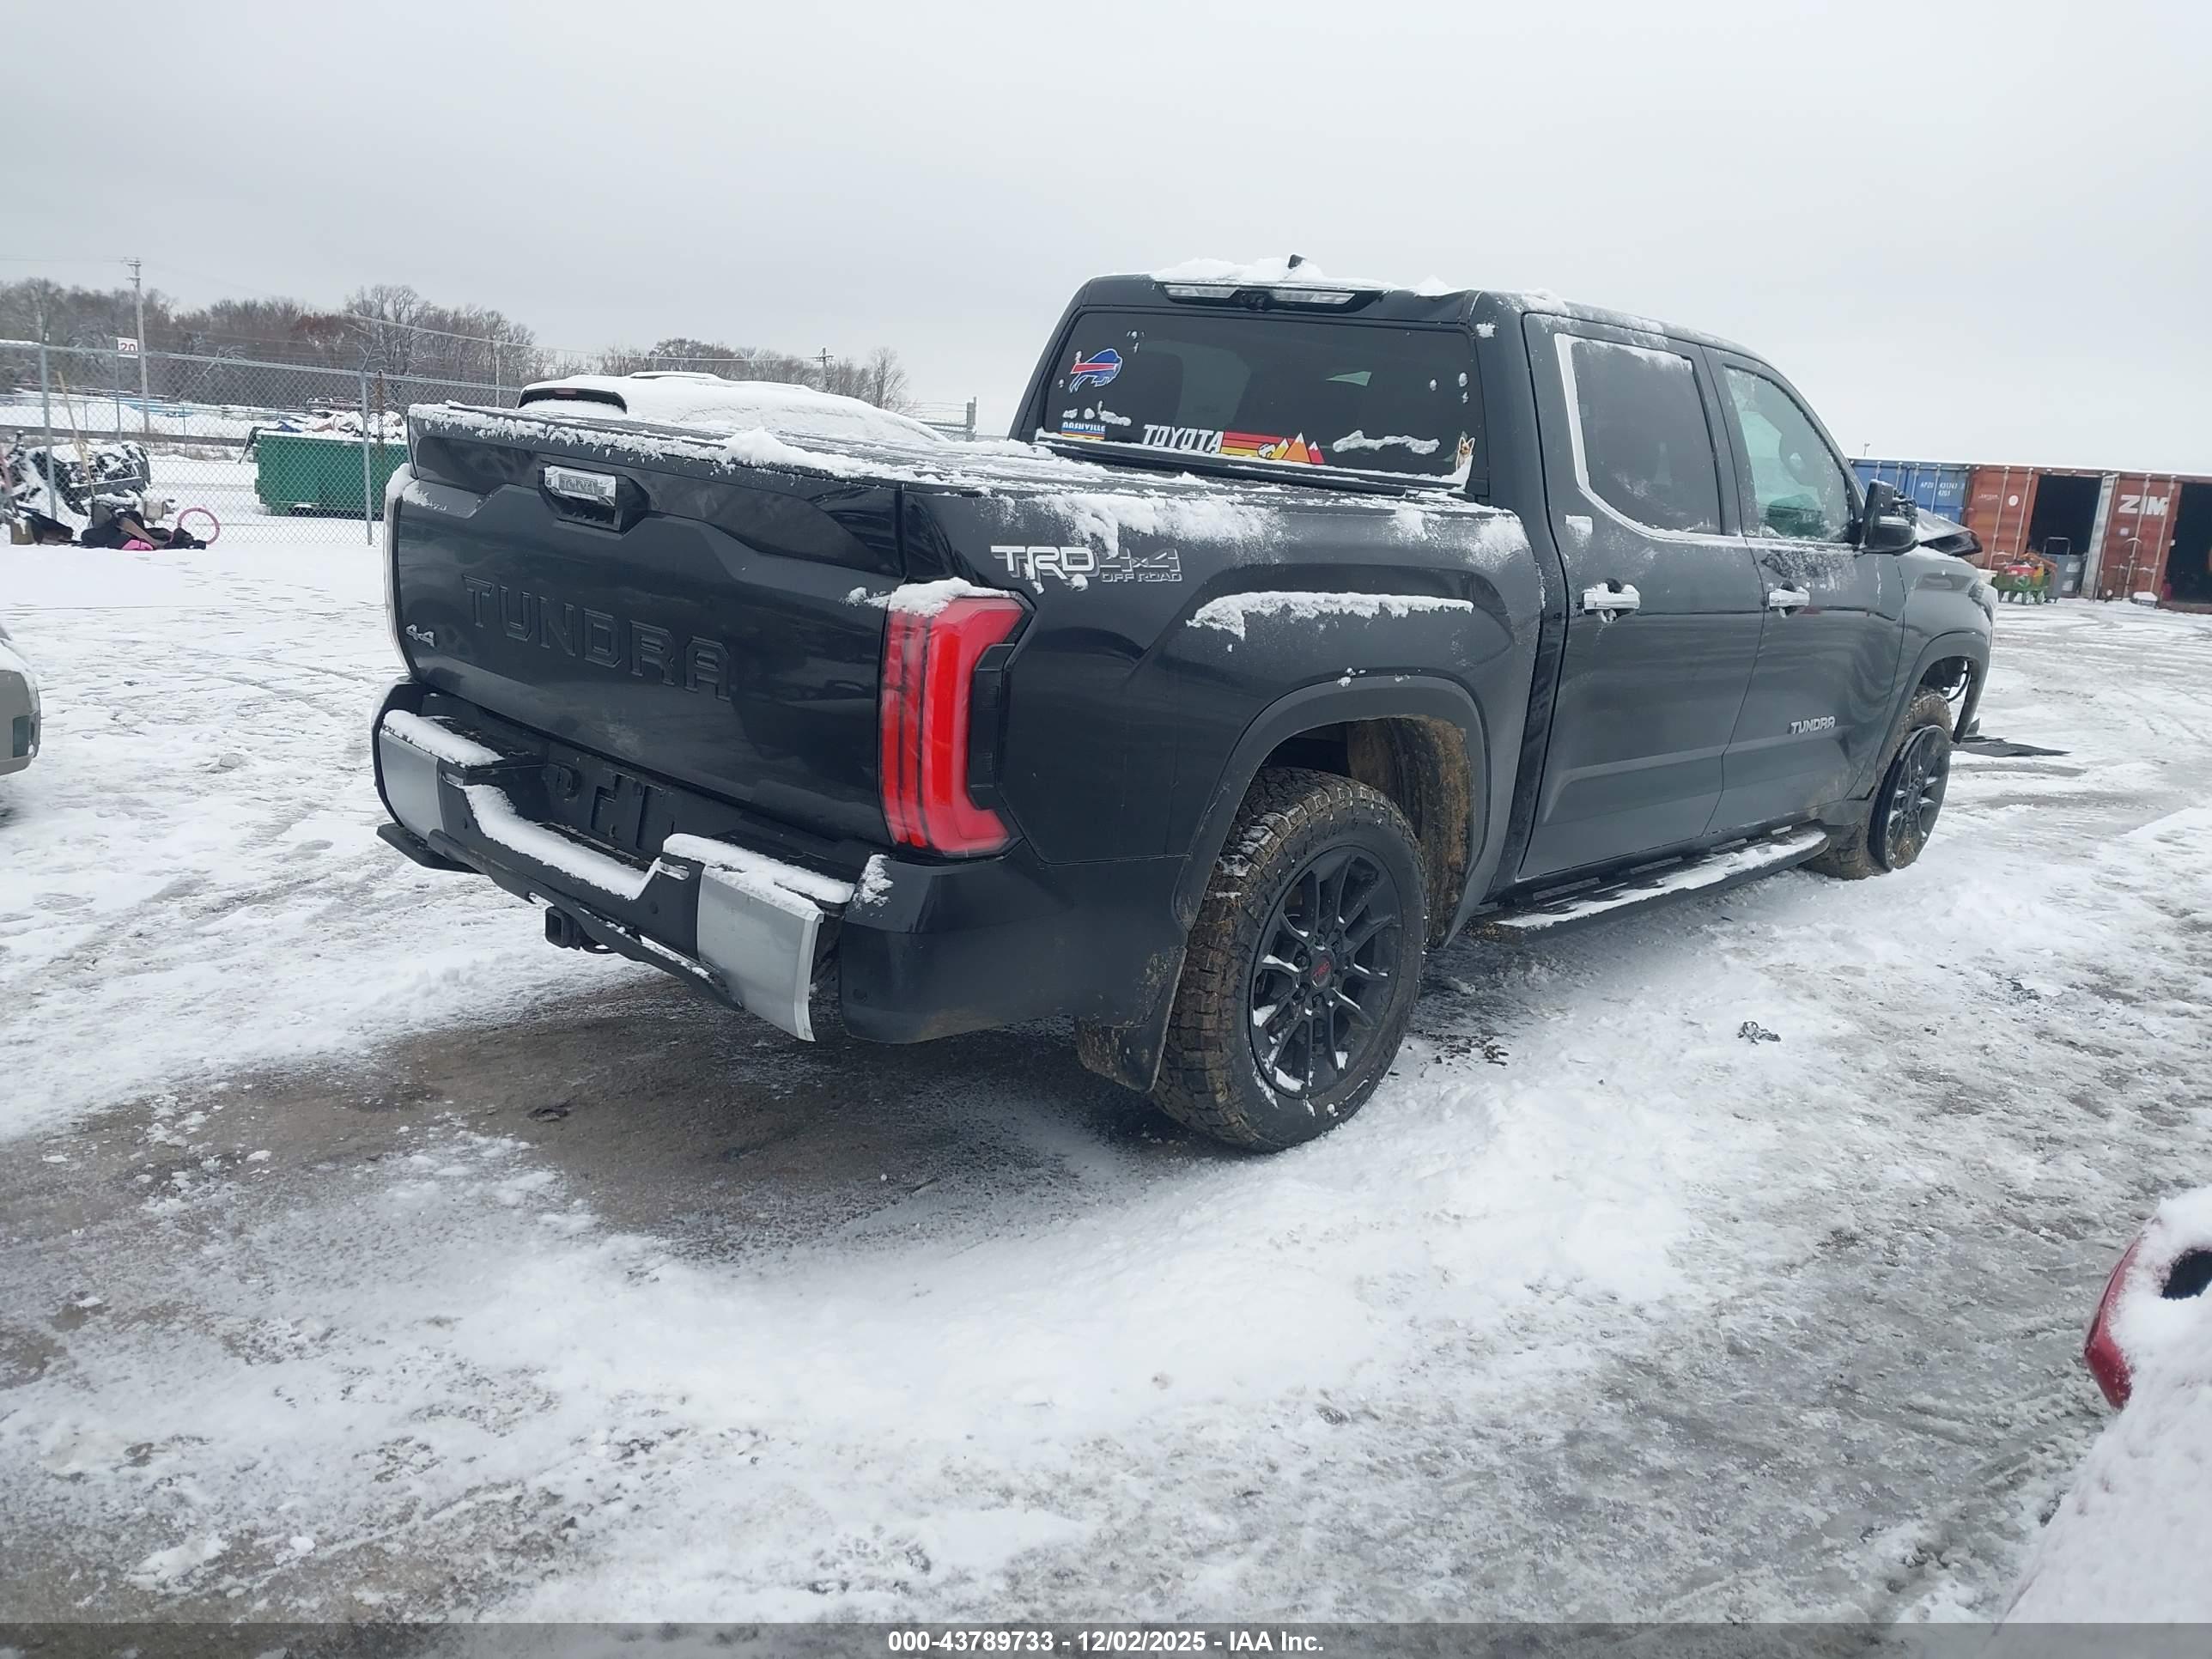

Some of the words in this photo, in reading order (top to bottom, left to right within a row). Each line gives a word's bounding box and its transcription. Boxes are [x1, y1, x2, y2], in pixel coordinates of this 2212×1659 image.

[1143, 424, 1224, 453] TOYOTA
[2118, 495, 2171, 515] ZIM
[991, 545, 1100, 581] TRD
[1102, 572, 1135, 582] OFF
[1138, 572, 1182, 582] ROAD
[462, 574, 730, 702] TUNDRA
[1790, 715, 1836, 734] TUNDRA
